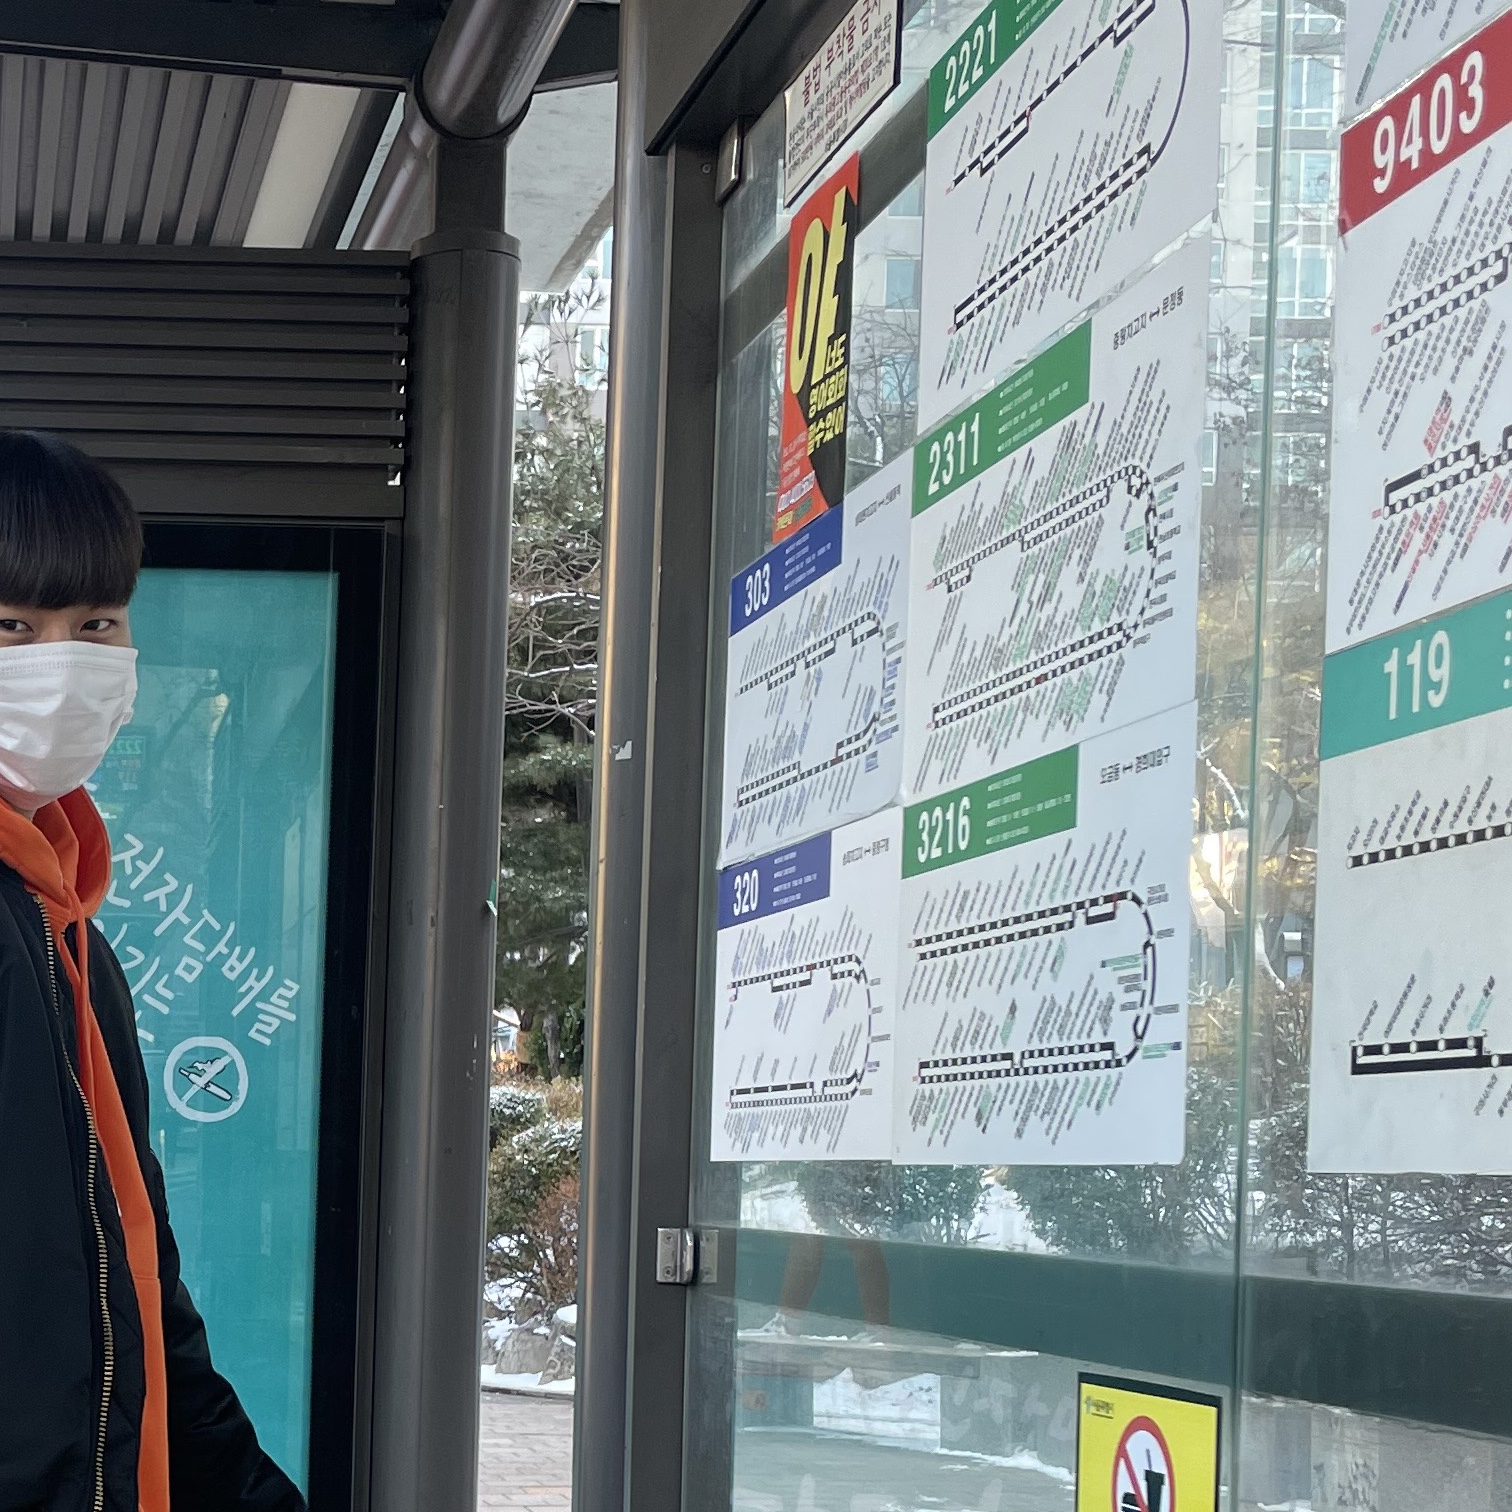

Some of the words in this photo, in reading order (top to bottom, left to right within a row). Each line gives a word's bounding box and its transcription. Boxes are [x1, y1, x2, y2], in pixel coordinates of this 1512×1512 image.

[802, 55, 822, 107] 불법
[824, 15, 856, 76] 부착물
[944, 8, 996, 114] 2221
[1373, 49, 1484, 194] 9403
[789, 184, 849, 395] 야
[808, 364, 849, 420] 영어회화
[928, 411, 980, 496] 2311
[744, 579, 772, 620] 303
[1381, 630, 1454, 721] 119
[917, 796, 972, 863] 3216
[733, 868, 760, 917] 320
[105, 832, 301, 1047] 전자담배를
